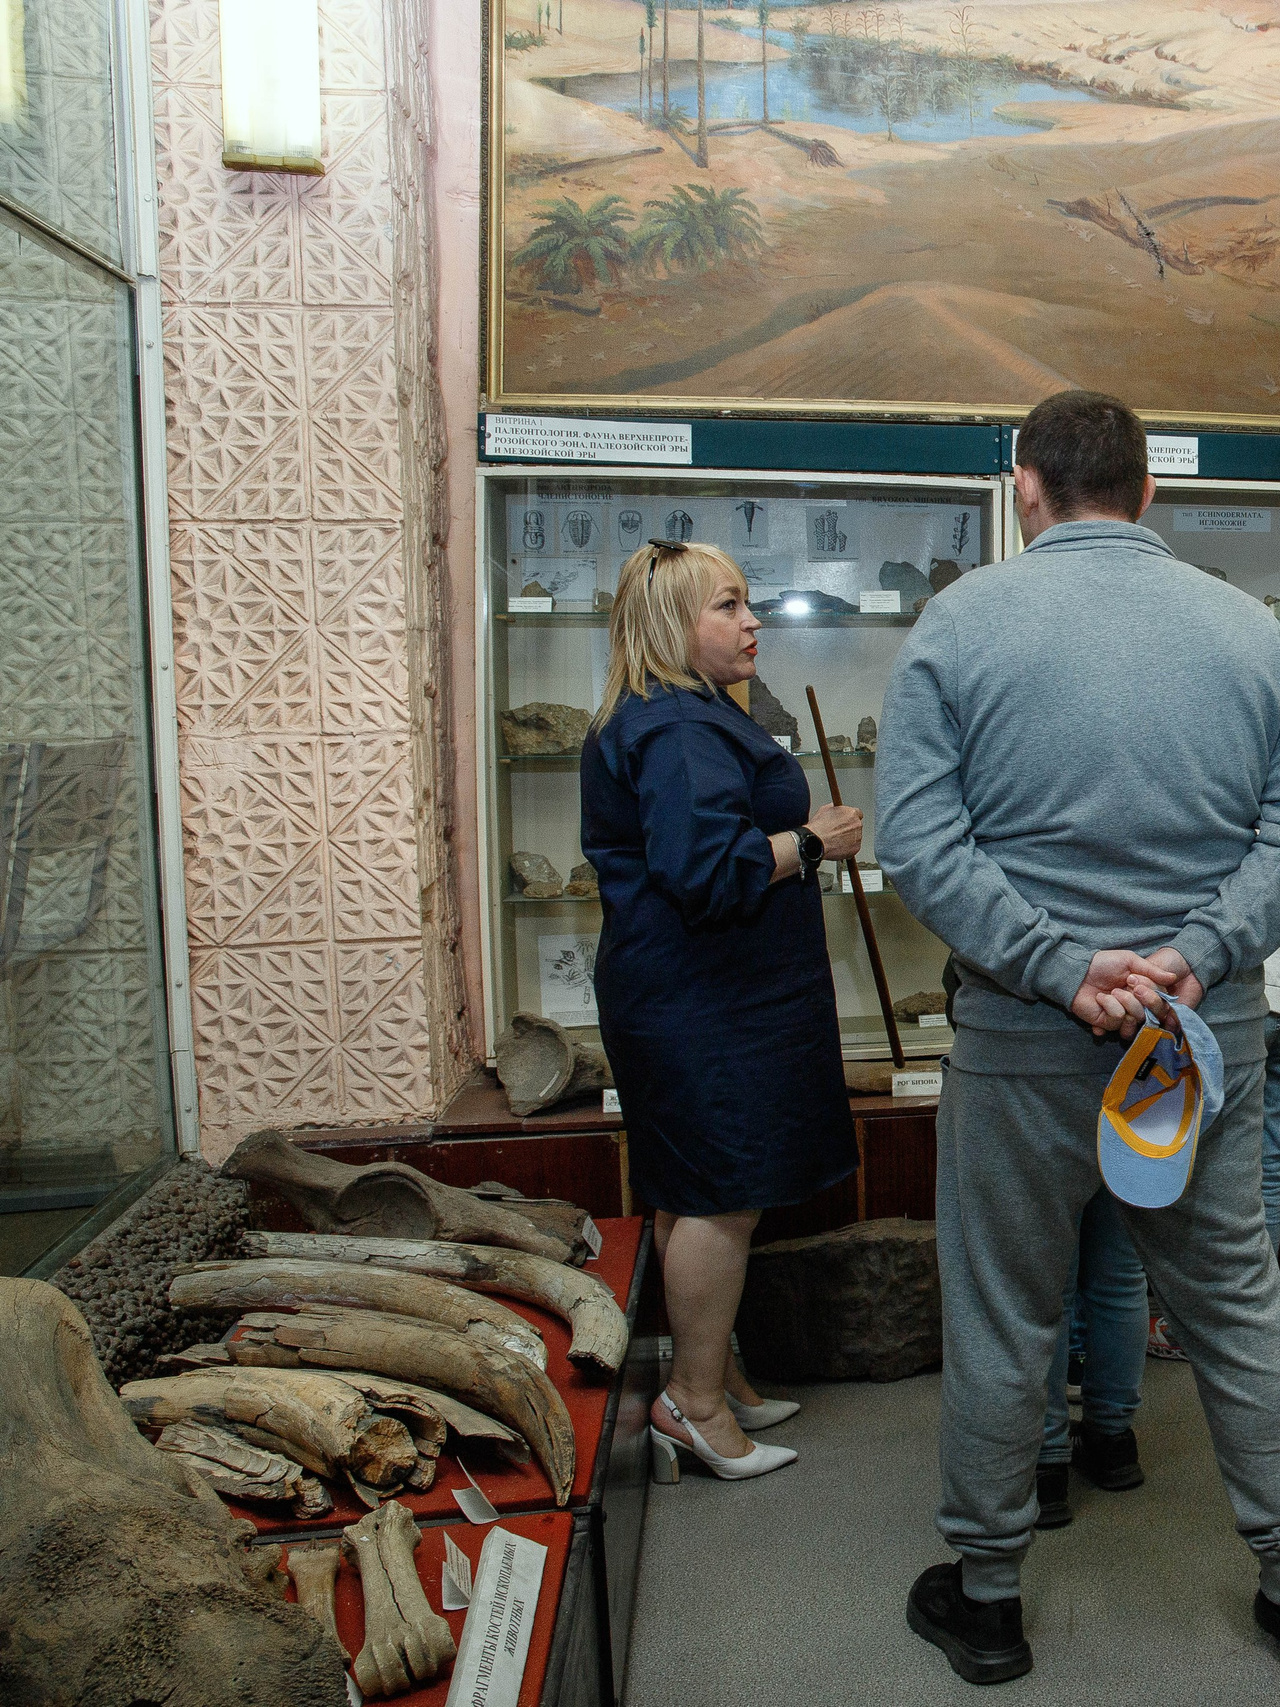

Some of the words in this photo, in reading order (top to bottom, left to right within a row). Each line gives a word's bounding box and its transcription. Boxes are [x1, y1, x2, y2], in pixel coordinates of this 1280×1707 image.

[495, 416, 537, 426] ВИТРИНА
[539, 419, 543, 427] 1
[494, 426, 582, 439] ПАЛЕОНТОЛОГИЯ.
[582, 431, 616, 441] ФАУНА
[618, 433, 689, 443] ВЕРХНЕПРОТЕ-
[494, 436, 558, 447] РОЗОЙСКОГО
[559, 440, 588, 450] ЭОНА,
[589, 441, 667, 453] ПАЛЕОЗОЙСКОЙ
[668, 444, 689, 453] ЭРЫ
[1148, 446, 1195, 455] ХНЕПРОТЕ-
[494, 446, 501, 454] И
[503, 446, 574, 458] МЕЗОЗОЙСКОЙ
[576, 450, 597, 459] ЭРЫ
[1198, 511, 1264, 519] ECHINODERMATA.
[471, 1640, 498, 1707] ФРАГМЕНТЫ
[485, 1601, 505, 1641] КОСТЕЙ
[495, 1541, 517, 1604] ИСКОПАЕМЫХ
[503, 1597, 525, 1658] ЖИВОТНЫХ
